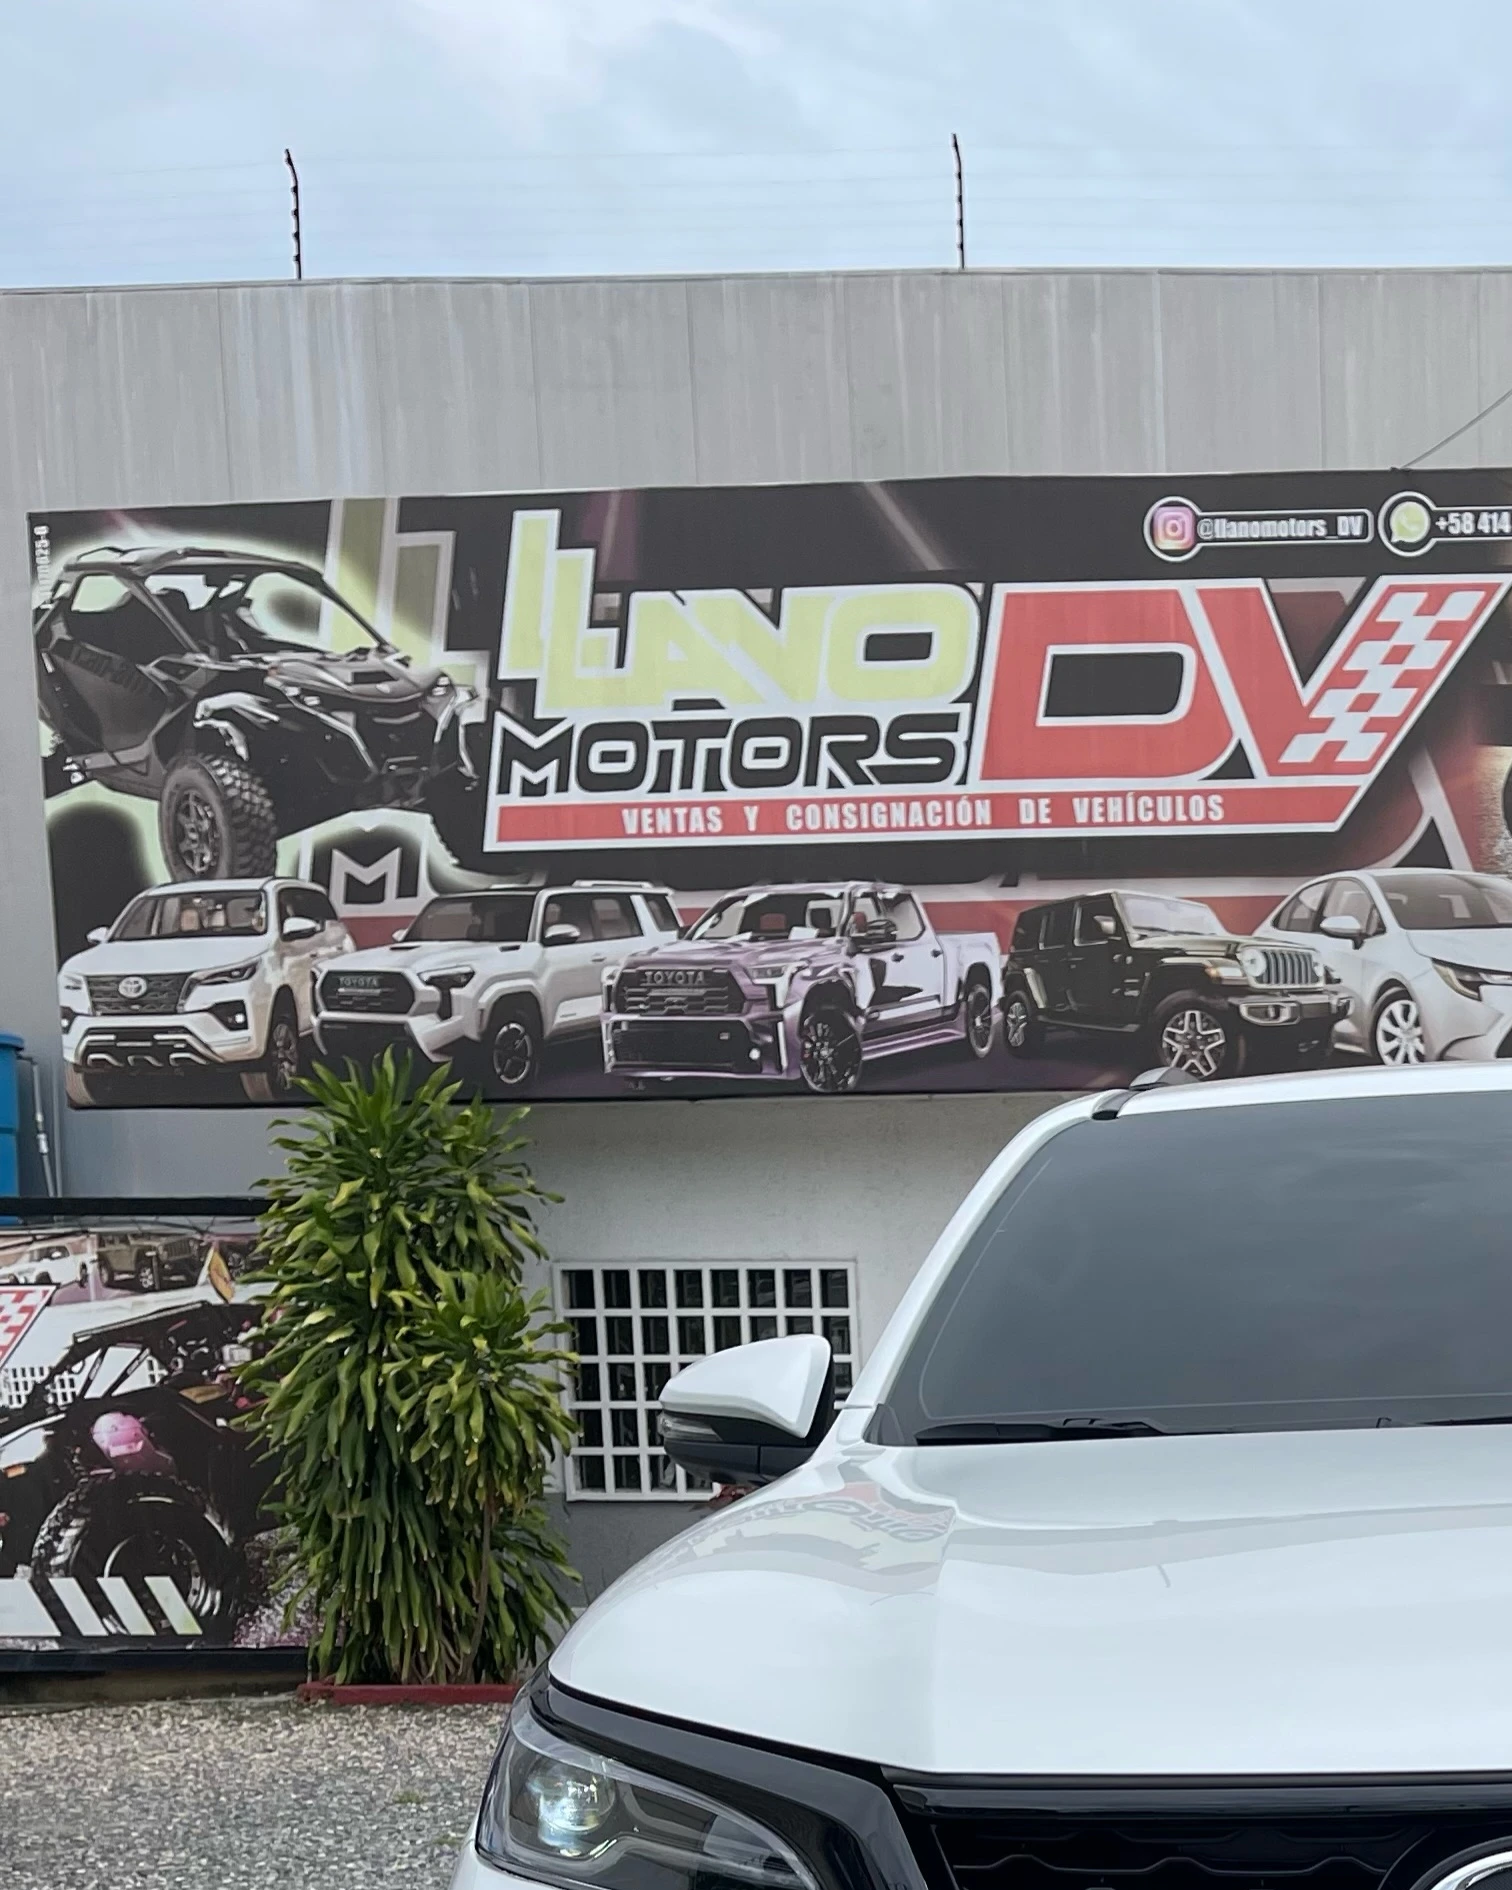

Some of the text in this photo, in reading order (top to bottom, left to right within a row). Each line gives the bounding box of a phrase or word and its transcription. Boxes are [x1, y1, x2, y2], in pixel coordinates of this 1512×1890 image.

[1197, 515, 1363, 540] @llanomotors_DV
[1436, 512, 1475, 534] +58
[1477, 511, 1512, 533] 414
[499, 509, 981, 718] LLANO
[498, 712, 968, 796] MOTORS
[622, 791, 1225, 834] VENTAS Y CONSIGNACIÓN DE VEHÍCULOS
[339, 975, 378, 987] TOYOTA
[644, 971, 705, 985] TOYOTA
